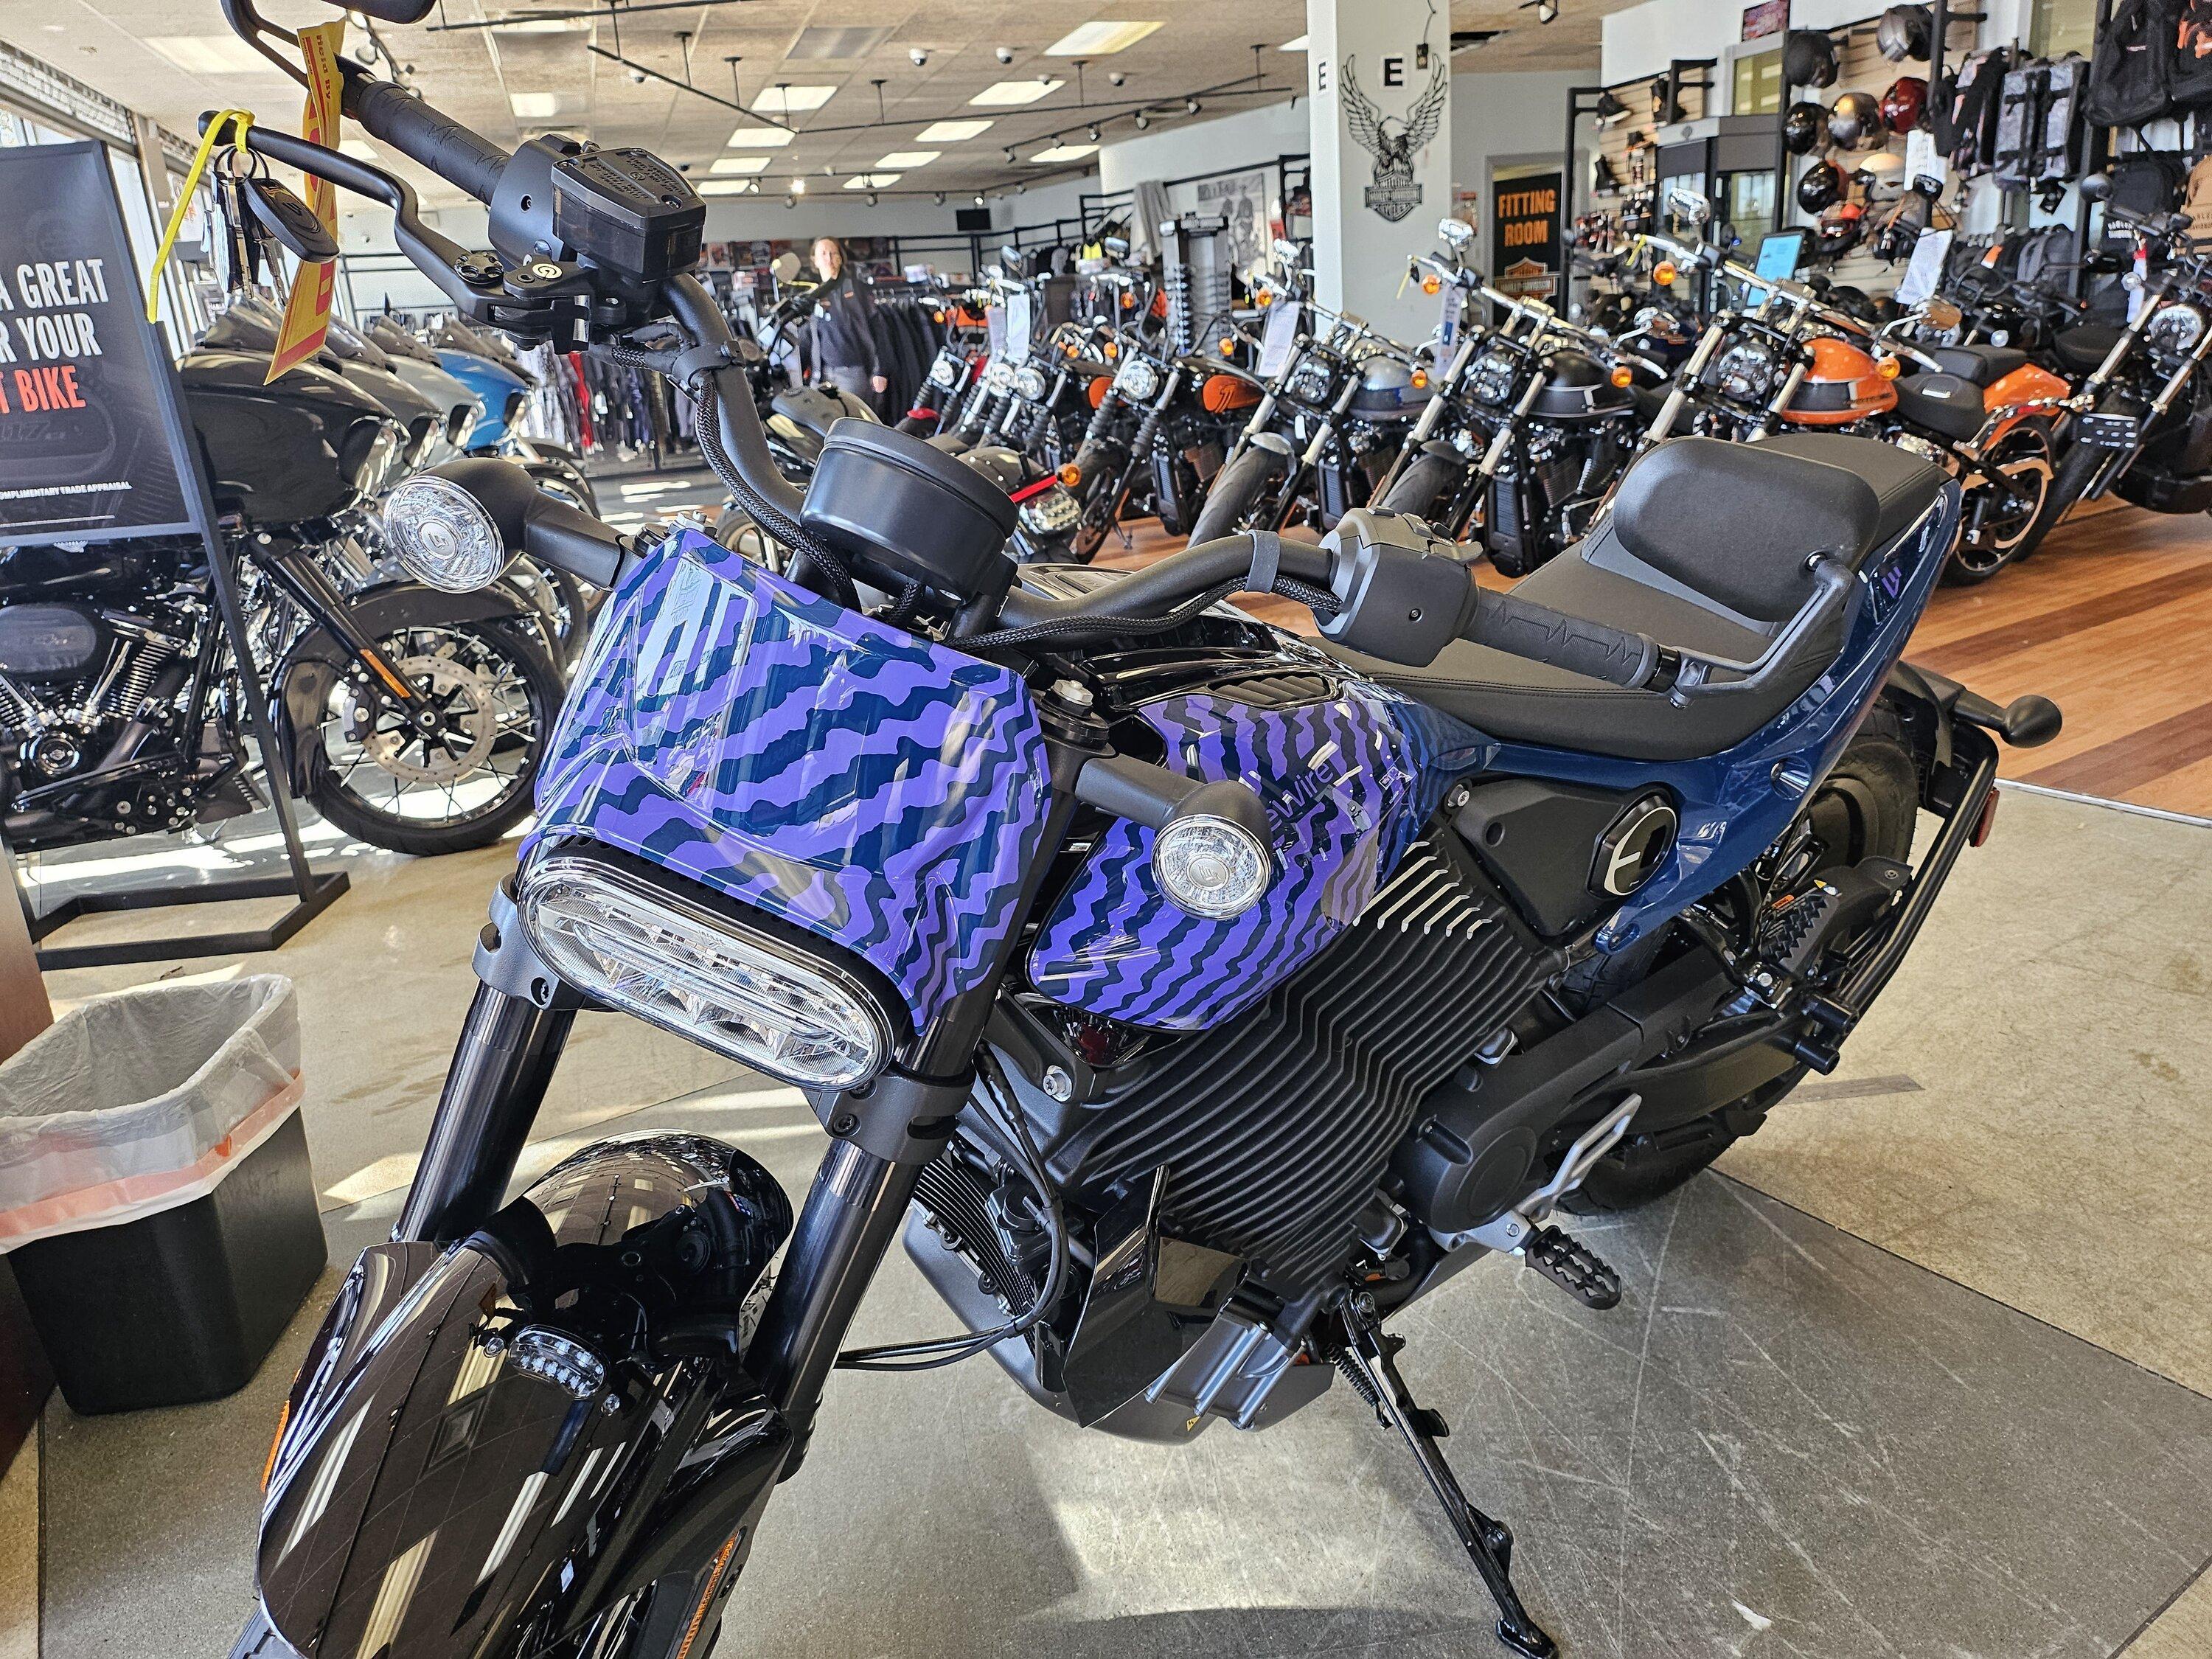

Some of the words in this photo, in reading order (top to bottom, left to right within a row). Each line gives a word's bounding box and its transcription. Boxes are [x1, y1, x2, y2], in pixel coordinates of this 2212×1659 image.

[1384, 58, 1403, 86] E
[1498, 189, 1557, 219] FITTING
[1504, 220, 1548, 248] ROOM
[16, 258, 109, 309] GREAT
[15, 312, 102, 361] YOUR
[14, 364, 87, 413] BIKE
[59, 484, 88, 495] TRADE
